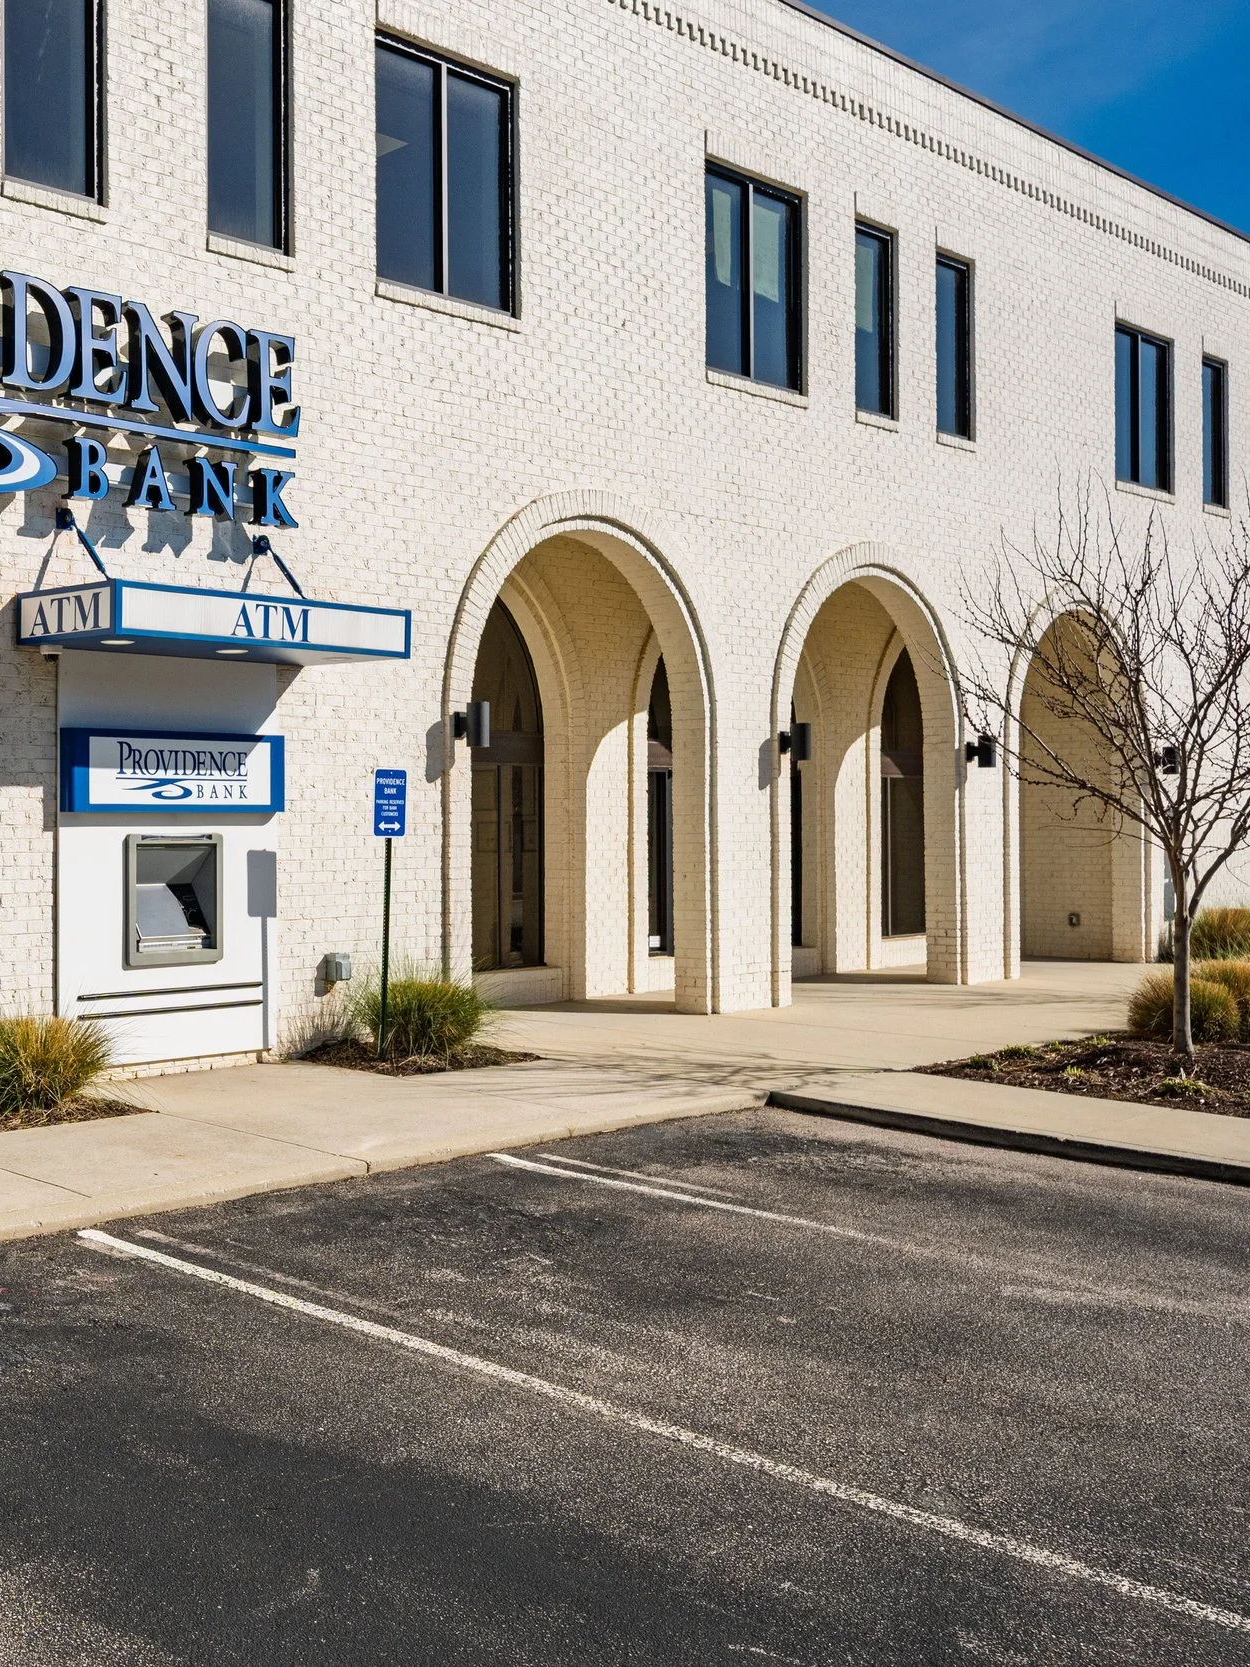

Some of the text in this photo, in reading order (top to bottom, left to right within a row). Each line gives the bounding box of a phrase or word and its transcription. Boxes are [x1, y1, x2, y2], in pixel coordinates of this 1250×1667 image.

[62, 435, 299, 528] BANK
[30, 592, 103, 637] ATM
[232, 602, 312, 643] ATM
[116, 741, 248, 776] PROVIDENCE
[196, 784, 248, 798] BANK
